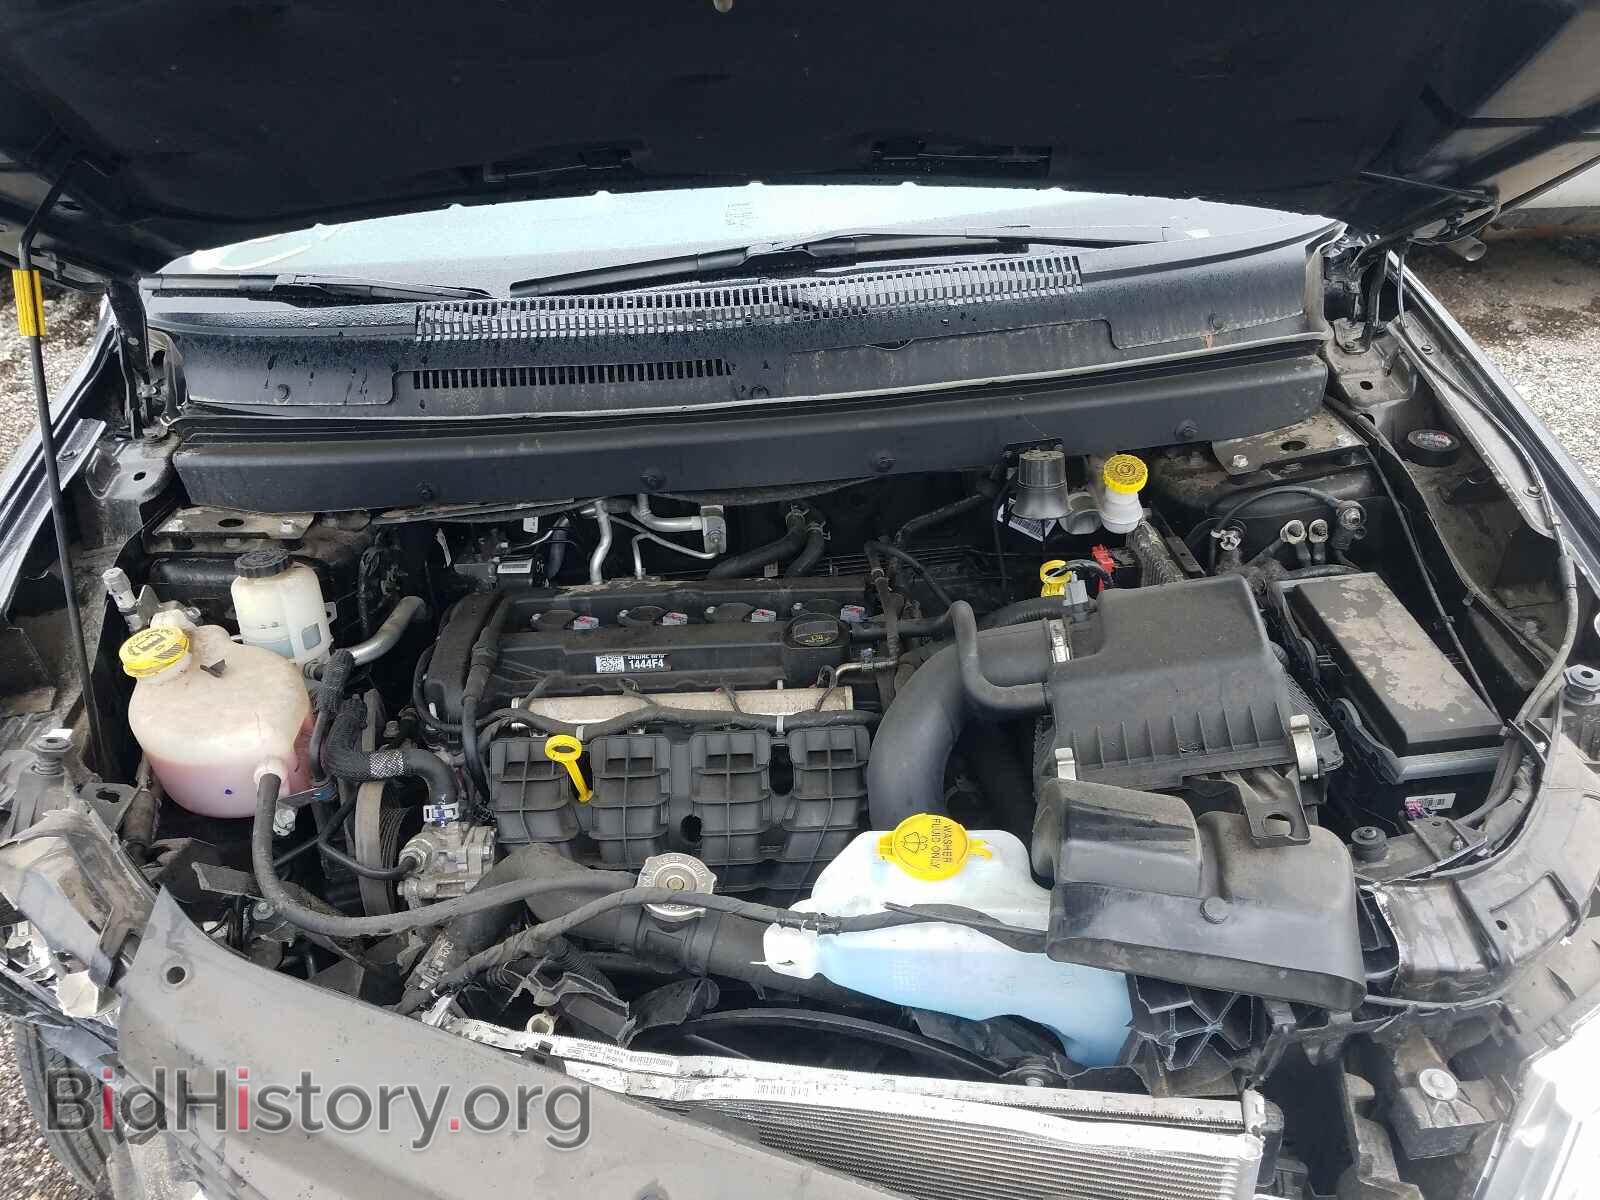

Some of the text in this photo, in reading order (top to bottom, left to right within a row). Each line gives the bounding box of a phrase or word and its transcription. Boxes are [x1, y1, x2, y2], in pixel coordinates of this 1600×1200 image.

[629, 658, 664, 669] 1444F4
[930, 818, 941, 870] FLUID ONLY
[943, 824, 953, 864] WASHER
